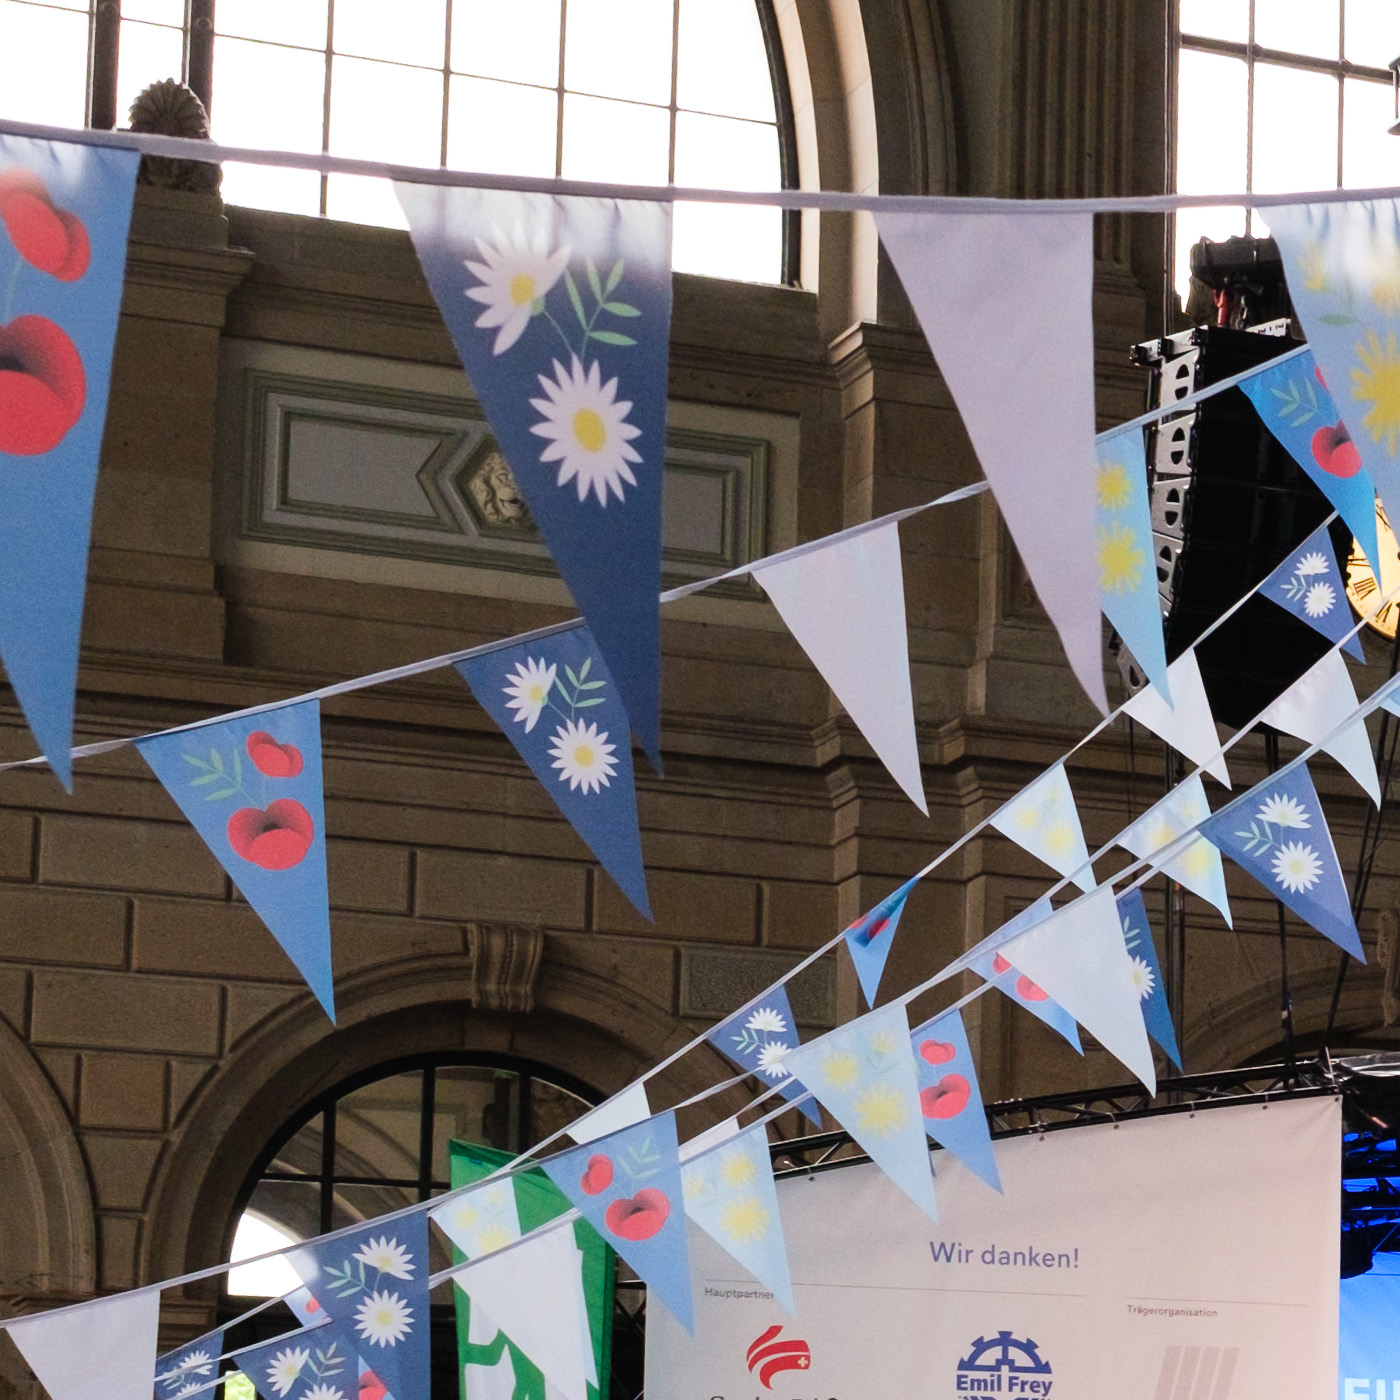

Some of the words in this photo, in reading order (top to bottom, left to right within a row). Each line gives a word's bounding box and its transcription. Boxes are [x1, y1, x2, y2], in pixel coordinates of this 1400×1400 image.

[929, 1241, 973, 1265] Wir
[980, 1243, 1081, 1268] danken!
[1127, 1304, 1218, 1319] Trägerorganisation
[956, 1373, 1001, 1394] Emil
[1007, 1375, 1053, 1398] Frey
